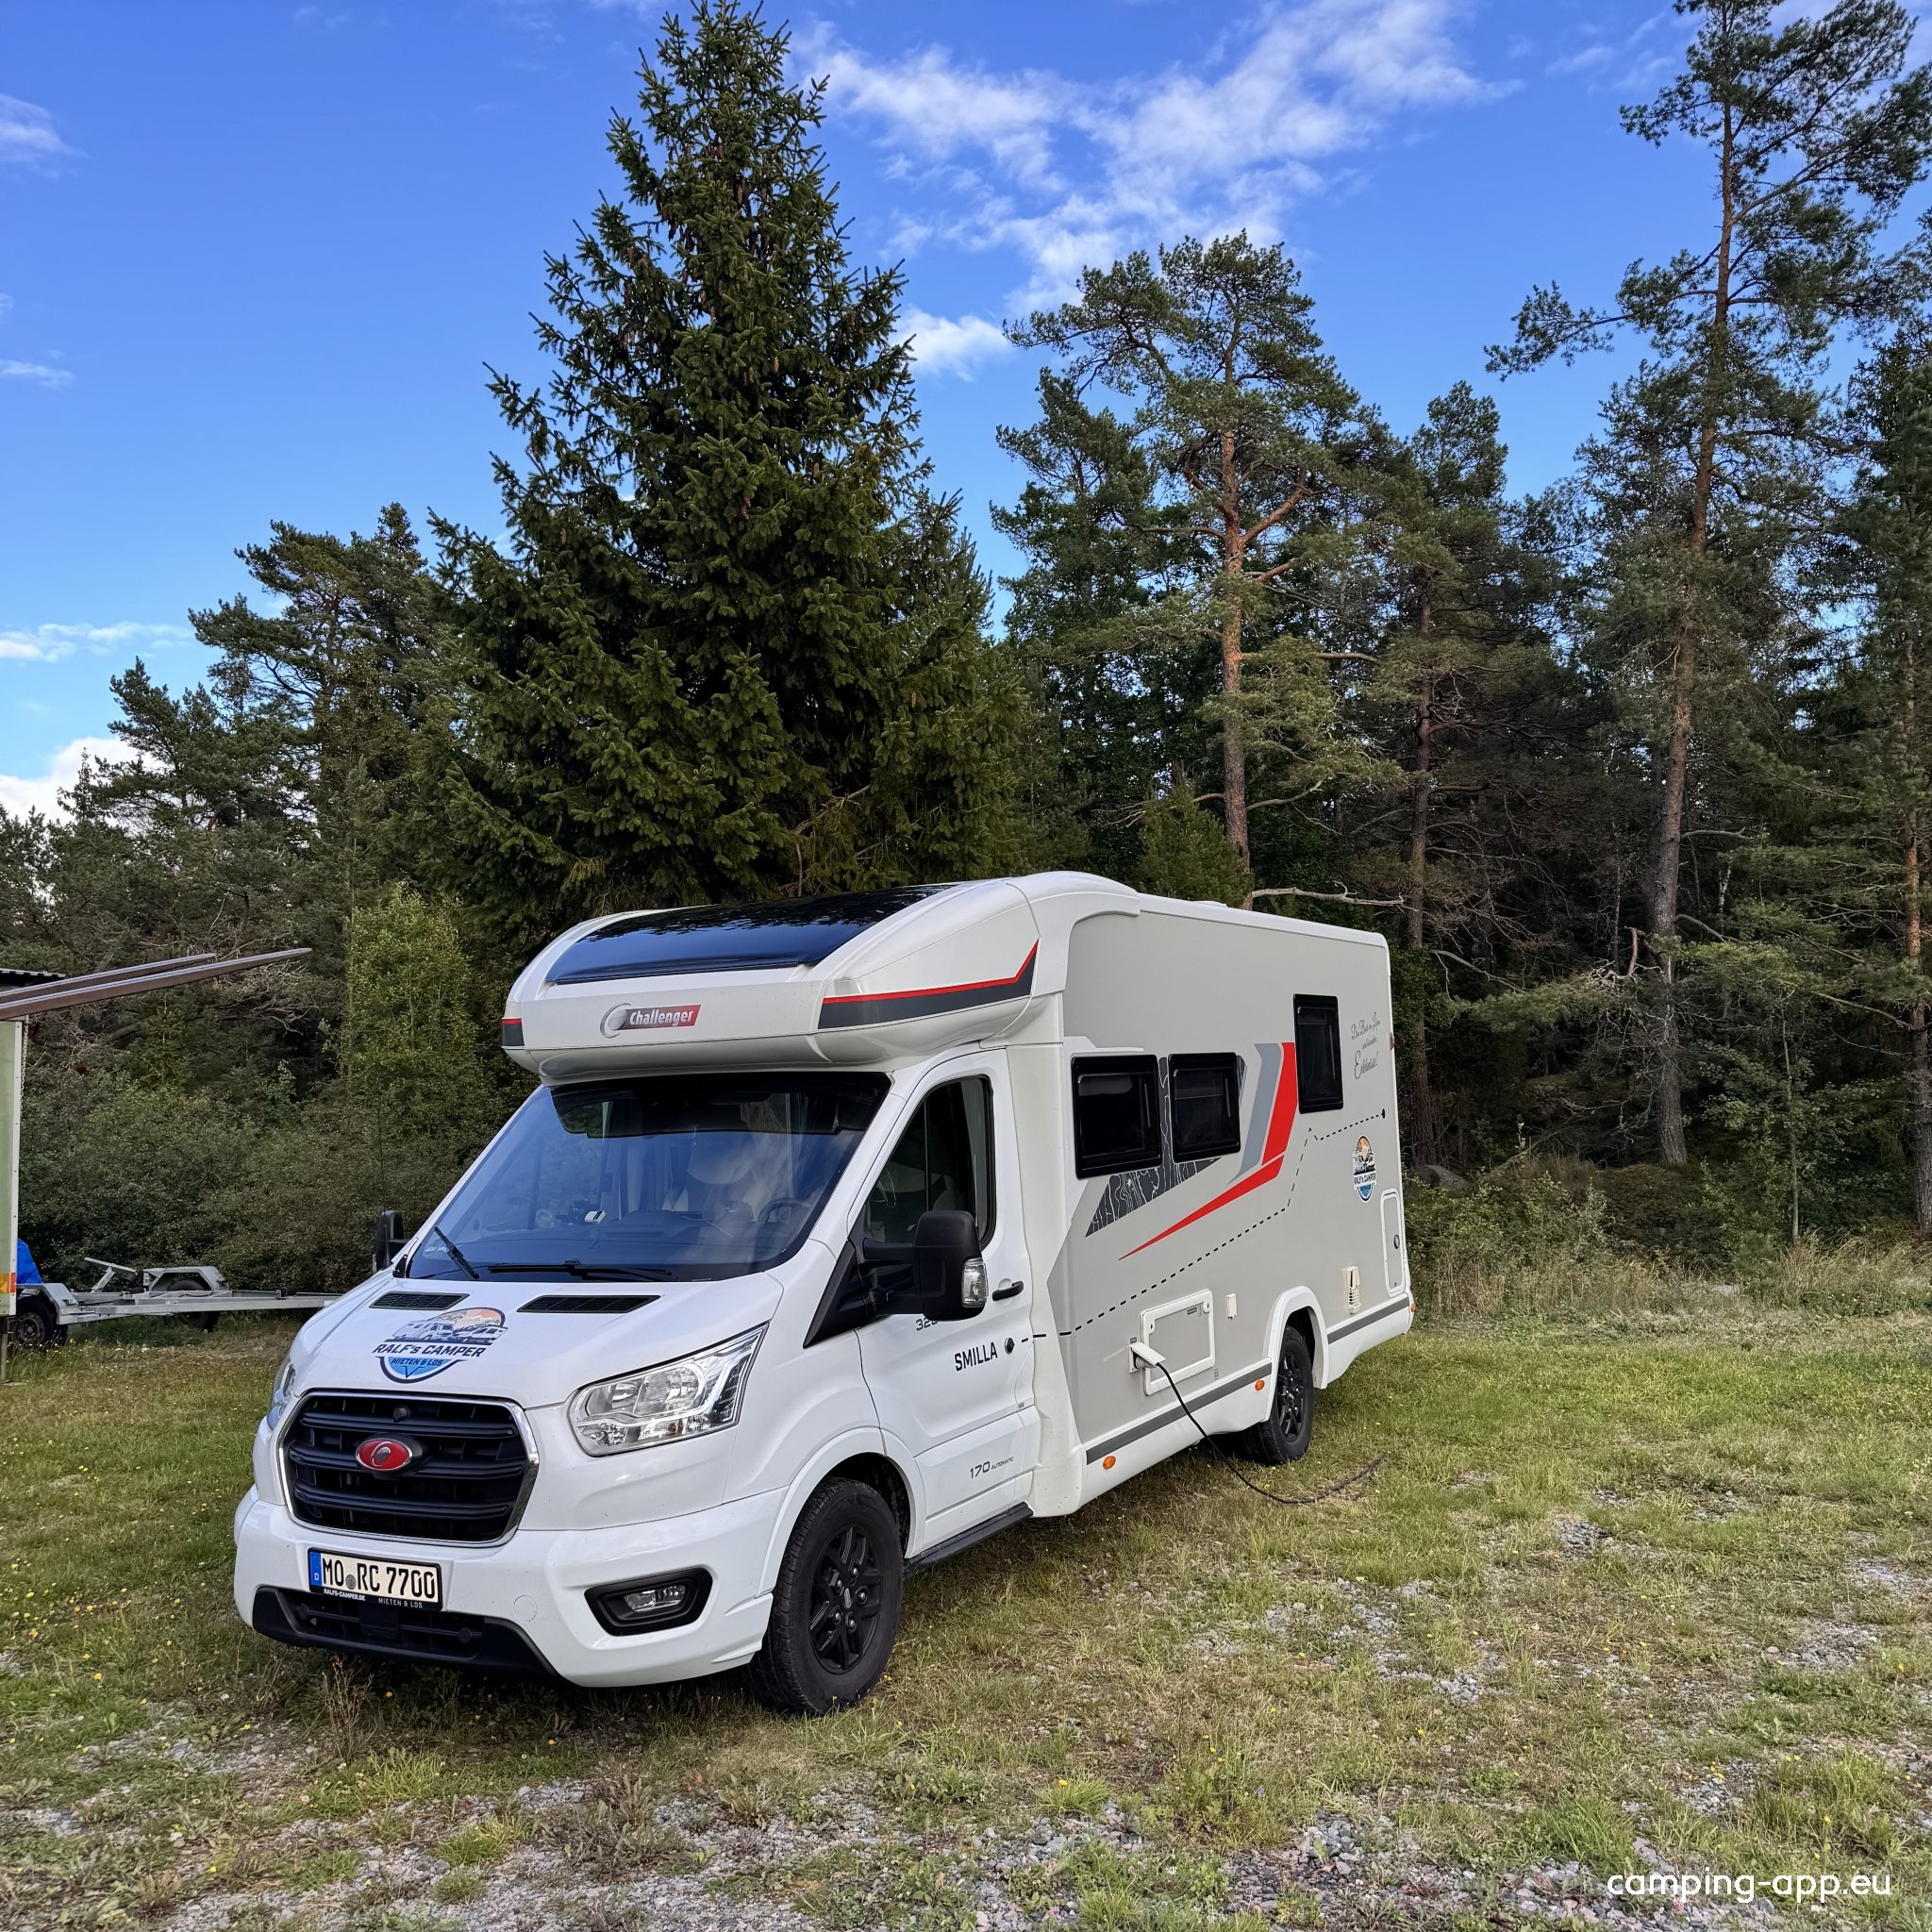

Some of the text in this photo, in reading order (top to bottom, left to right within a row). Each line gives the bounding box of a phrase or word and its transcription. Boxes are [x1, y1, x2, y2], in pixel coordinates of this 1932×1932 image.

[629, 1009, 694, 1026] Challenger
[373, 1344, 486, 1357] RALF's CAMPER
[954, 1341, 998, 1372] SMILLA
[427, 1358, 444, 1367] LOS
[970, 1460, 991, 1479] 170
[314, 1573, 320, 1581] D
[323, 1557, 436, 1599] MO RC 7700
[378, 1597, 402, 1607] MIETEN
